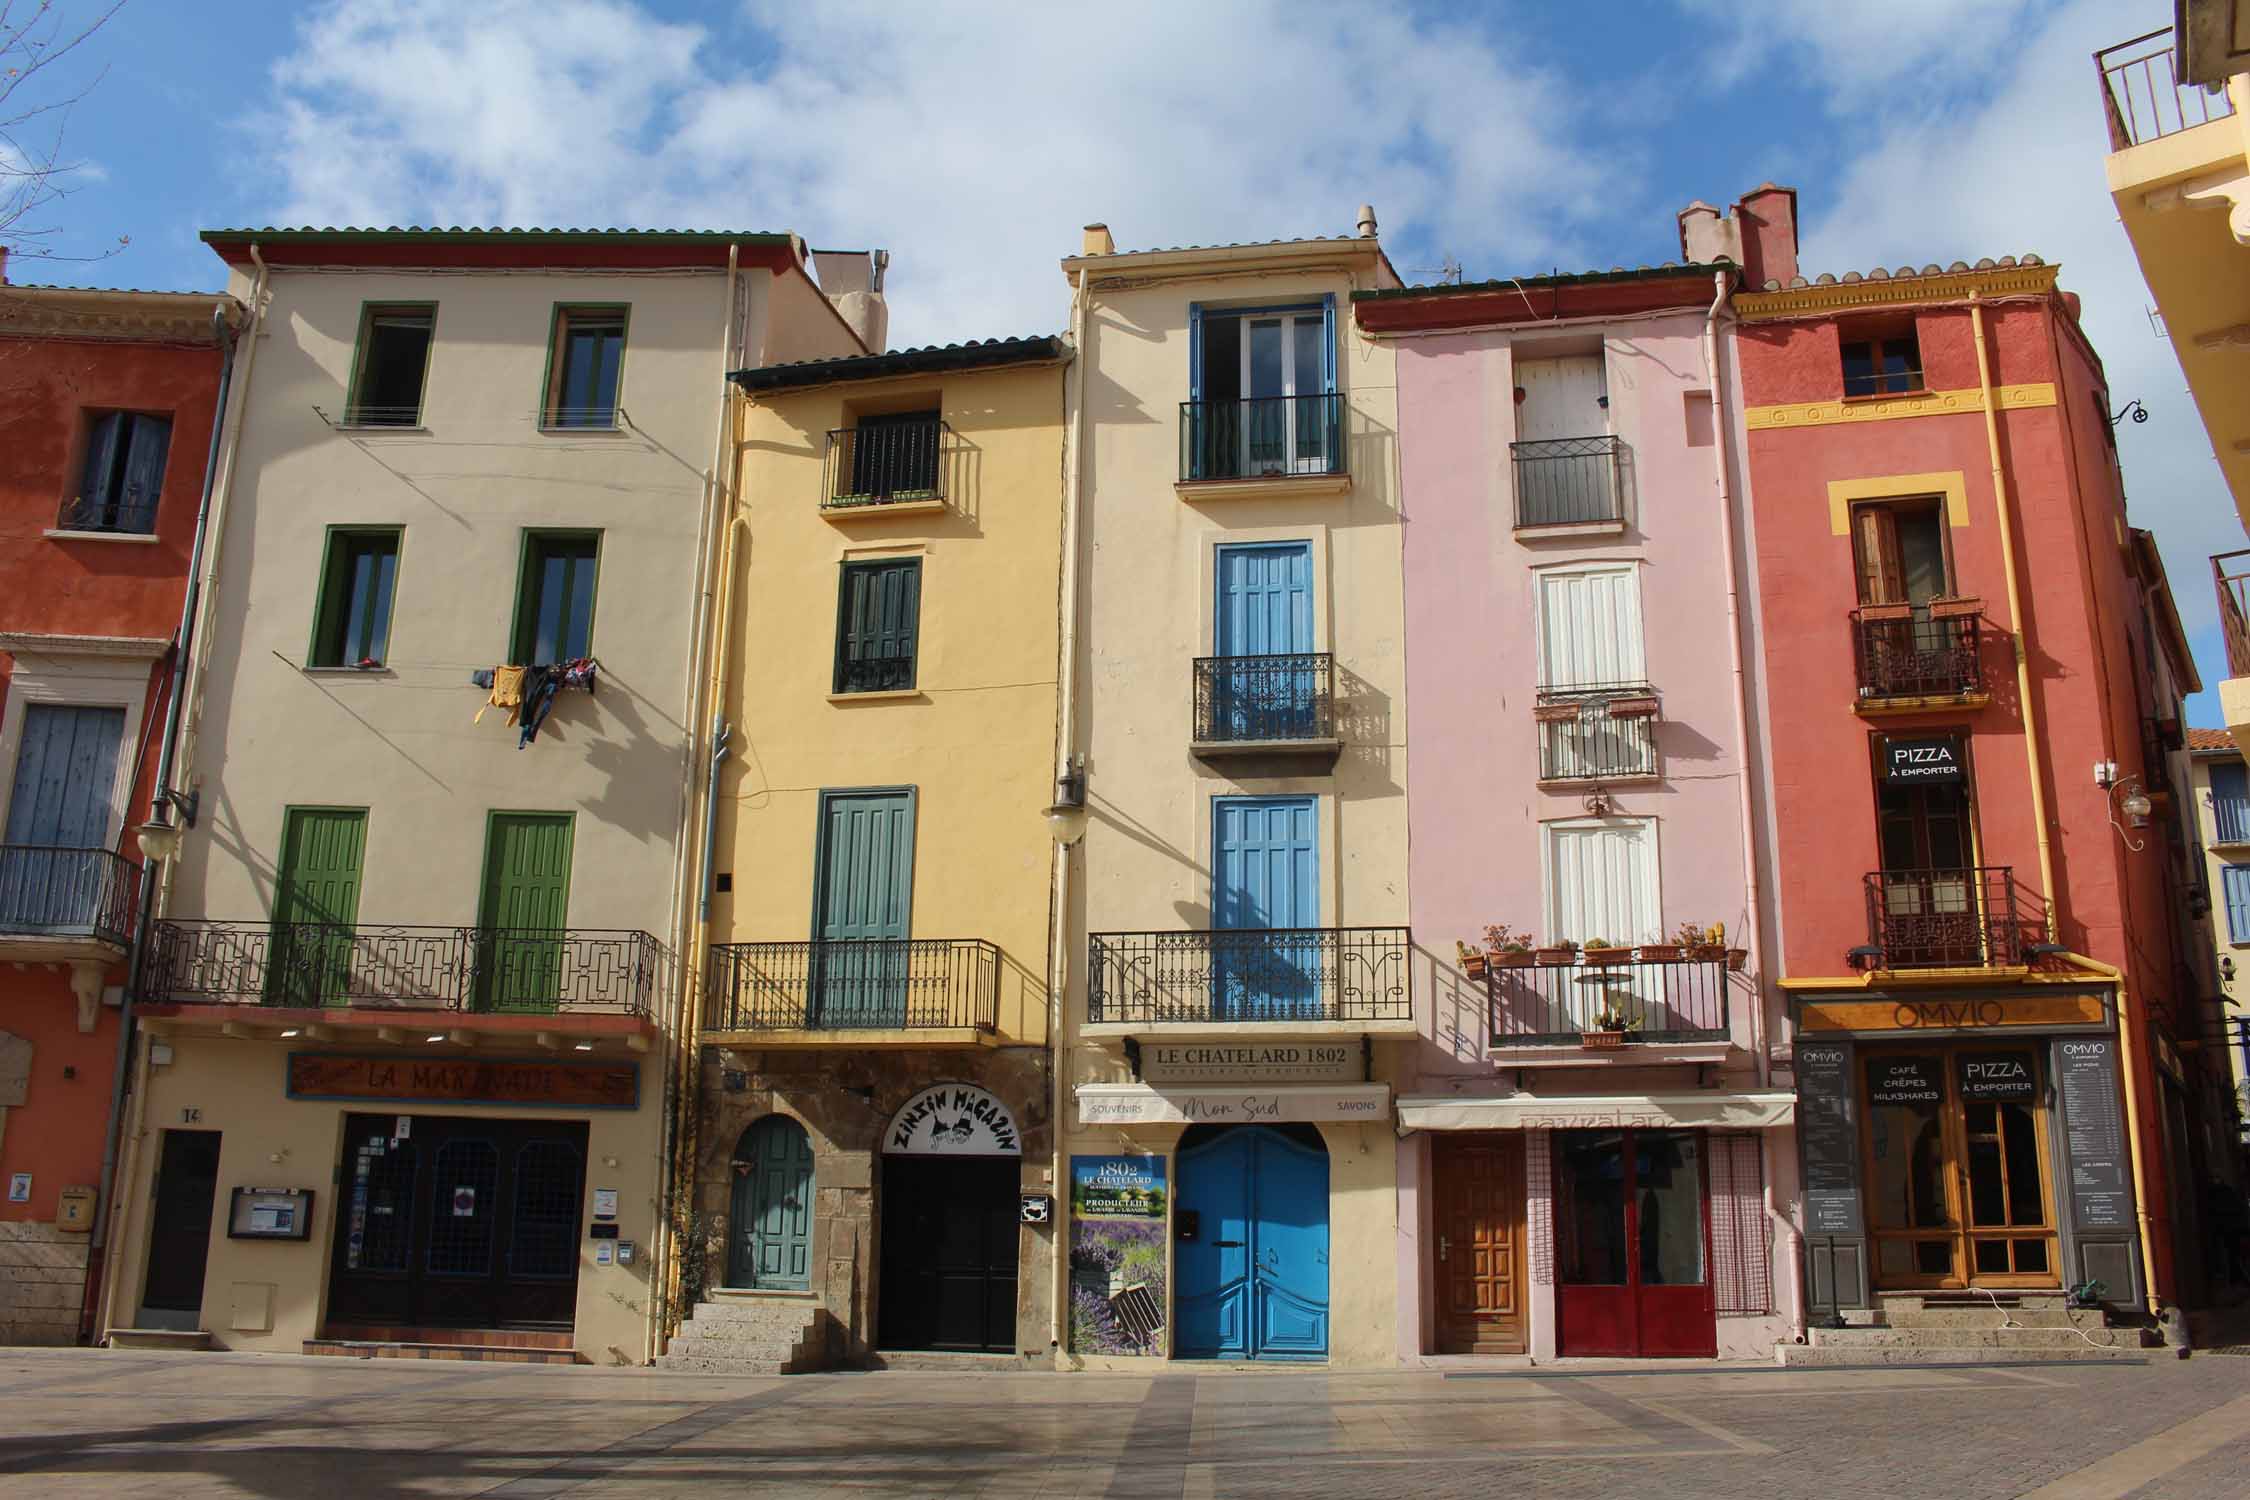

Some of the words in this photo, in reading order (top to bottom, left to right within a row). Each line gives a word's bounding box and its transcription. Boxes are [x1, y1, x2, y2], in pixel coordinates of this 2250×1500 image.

[1894, 747, 1952, 764] PIZZA
[1890, 767, 1898, 777] À
[1901, 766, 1958, 777] EMPORTER
[1895, 1000, 2004, 1029] OMVIO
[2063, 1043, 2105, 1055] OMVIO
[1157, 1048, 1179, 1064] LE
[1185, 1047, 1300, 1064] CHATELARD
[1307, 1047, 1346, 1063] 1802
[1803, 1051, 1844, 1063] OMVIO
[1889, 1063, 1919, 1075] CAFÉ
[1967, 1061, 2027, 1079] PIZZA
[368, 1063, 395, 1088] LA
[1883, 1077, 1927, 1088] CRÊPES
[1973, 1082, 2033, 1092] EMPORTER
[1873, 1090, 1939, 1102] MILKSHAKES
[1090, 1103, 1144, 1115] SOUVENIRS
[1183, 1096, 1233, 1119] Mon
[1241, 1095, 1280, 1121] Sud
[1336, 1101, 1377, 1112] SAVONS
[1099, 1160, 1137, 1177] 1802
[1084, 1176, 1096, 1185] LE
[1097, 1176, 1152, 1185] CHATELARD
[1085, 1199, 1149, 1208] PRODUCTEUR
